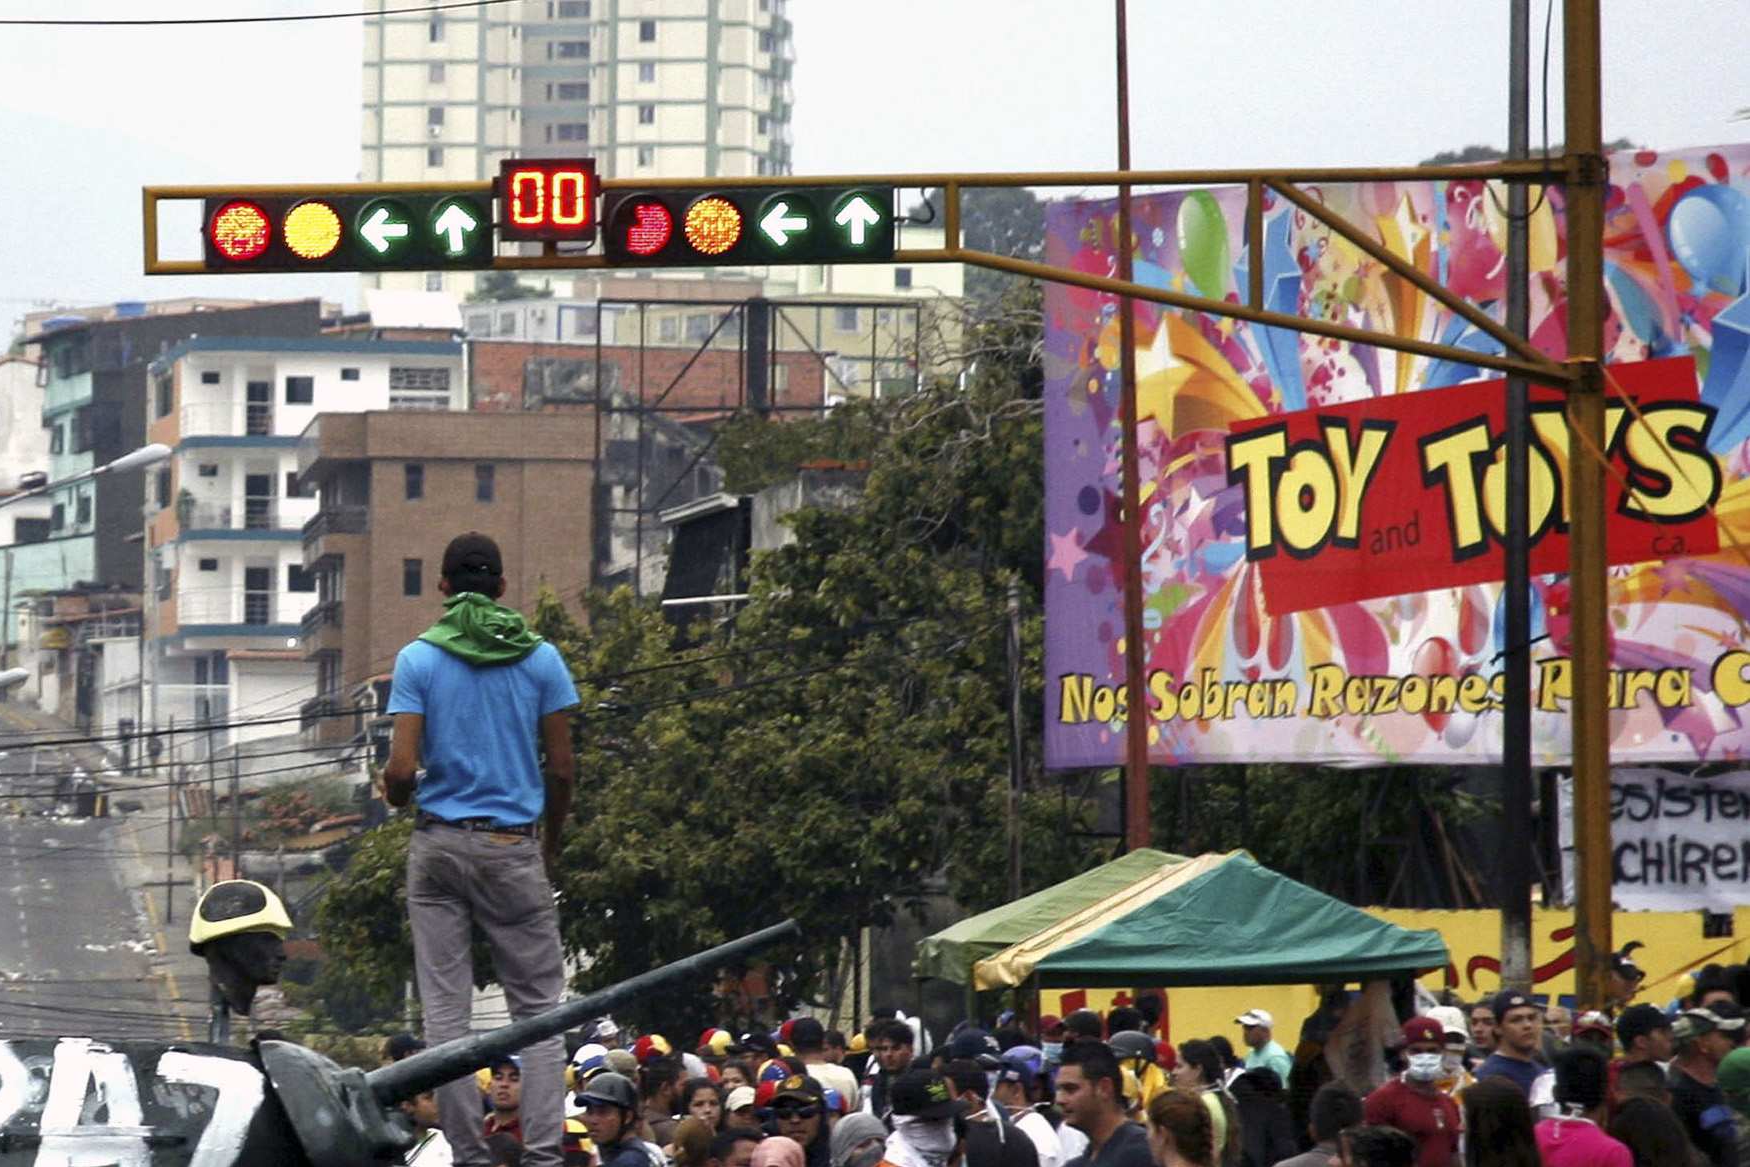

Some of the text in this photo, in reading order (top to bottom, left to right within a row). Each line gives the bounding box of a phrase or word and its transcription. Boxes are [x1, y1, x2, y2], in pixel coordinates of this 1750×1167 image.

[513, 171, 584, 225] 00
[1225, 415, 1399, 562] TOY
[1370, 511, 1421, 556] and
[1059, 672, 1129, 725] Nos
[1149, 667, 1298, 722] Sobran
[1307, 662, 1505, 718] Razones
[1536, 656, 1695, 713] Pra
